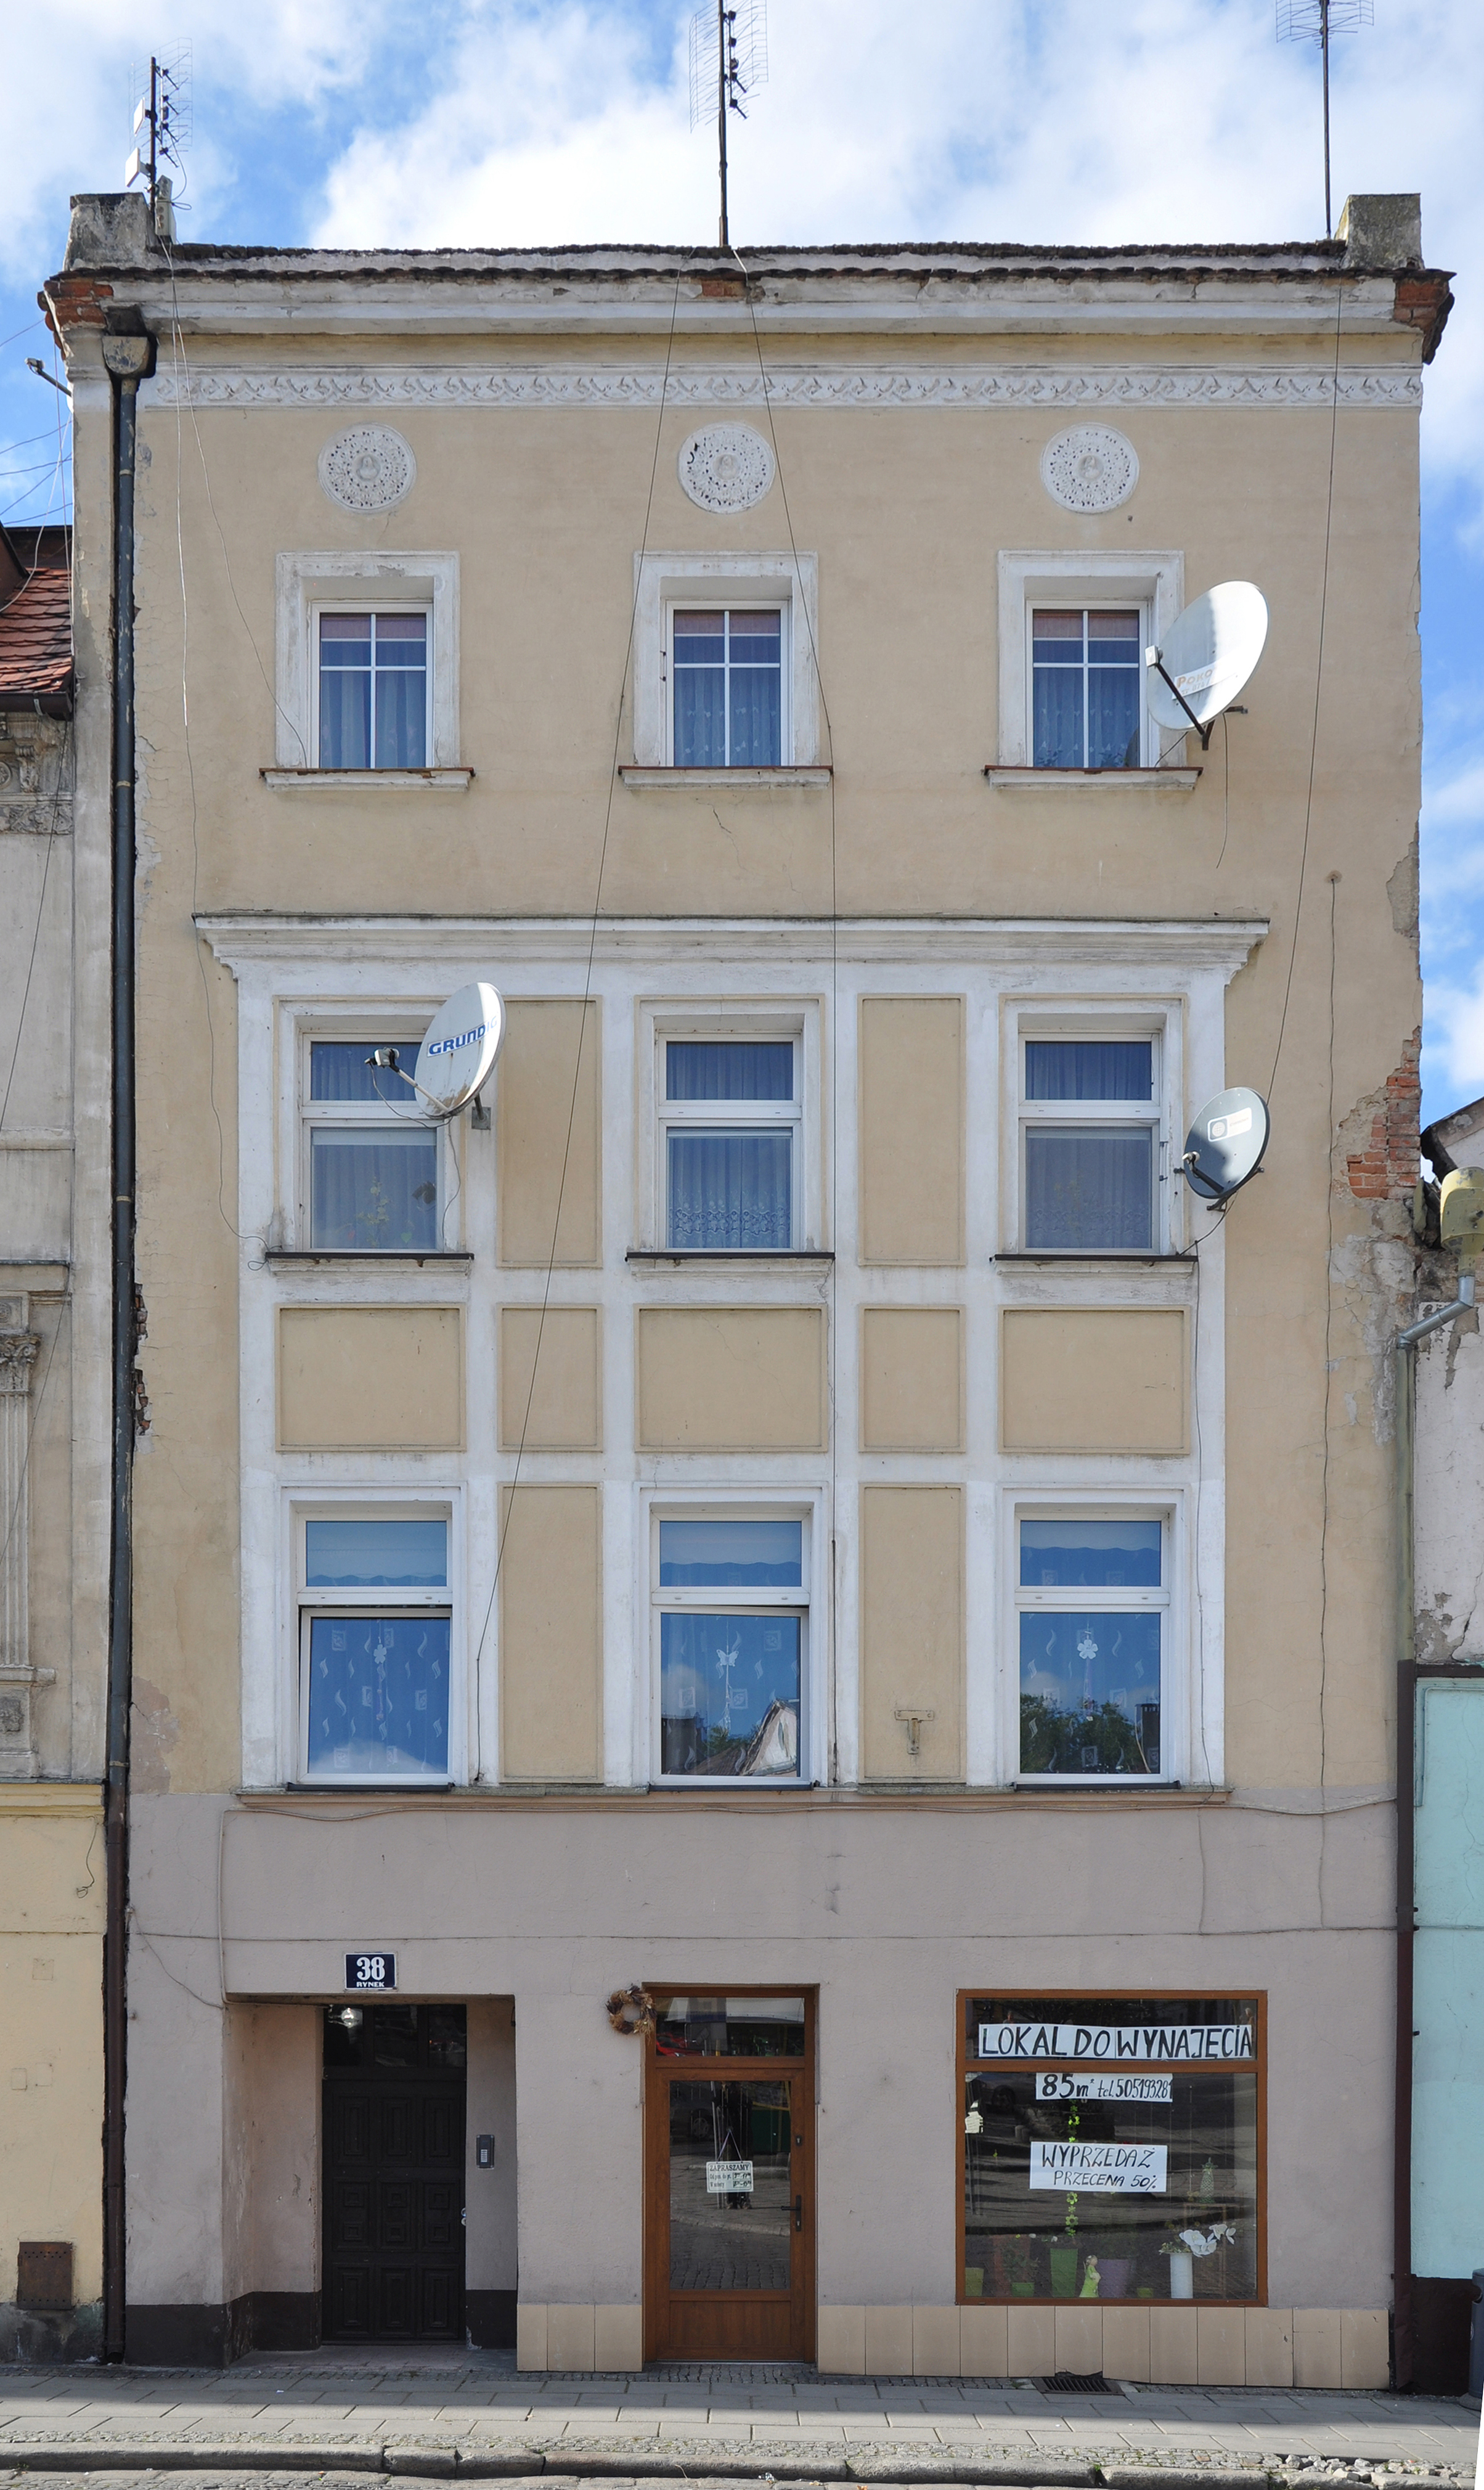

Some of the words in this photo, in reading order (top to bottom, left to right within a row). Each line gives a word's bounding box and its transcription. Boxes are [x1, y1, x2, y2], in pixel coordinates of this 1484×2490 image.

[356, 1956, 385, 1981] 38
[982, 2026, 1067, 2055] LOKAL
[1074, 2028, 1110, 2057] DO
[1042, 2144, 1155, 2168] WYPRZEDAŻ
[1054, 2170, 1125, 2187] PRZECENA
[1131, 2175, 1157, 2190] 50%
